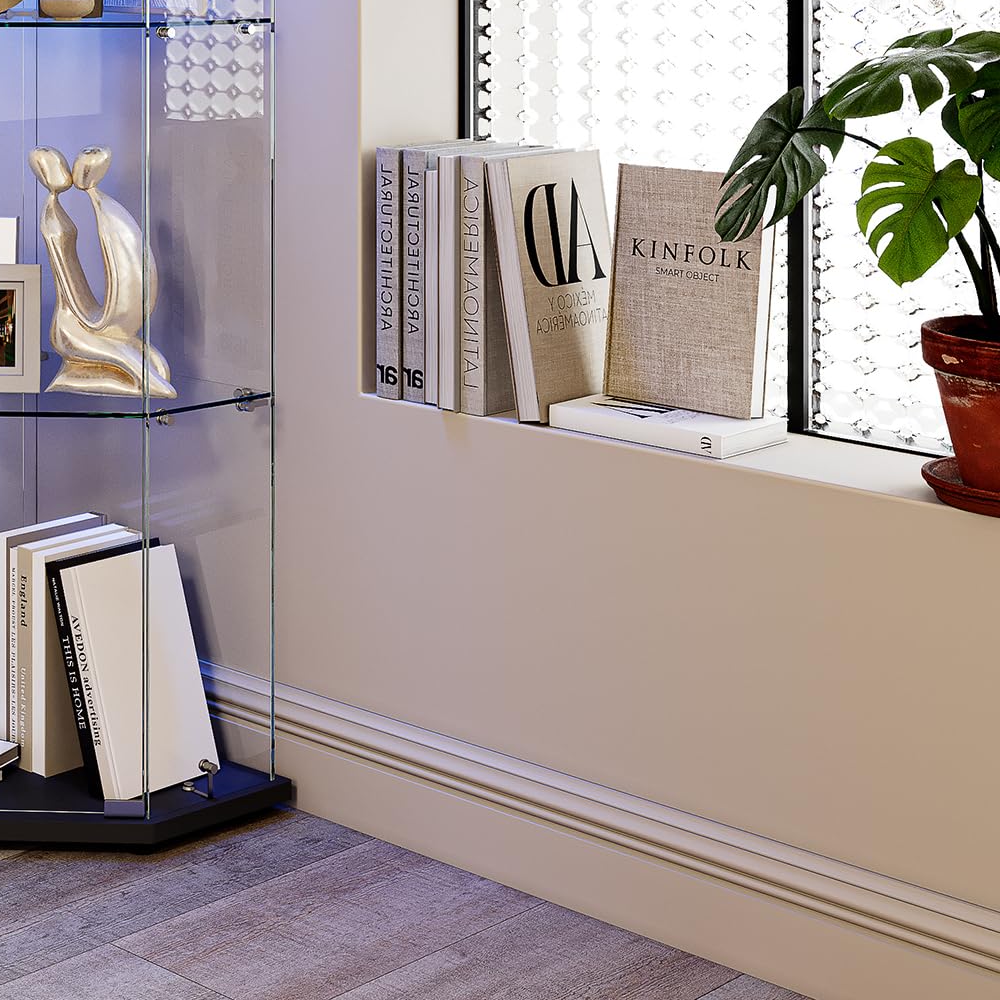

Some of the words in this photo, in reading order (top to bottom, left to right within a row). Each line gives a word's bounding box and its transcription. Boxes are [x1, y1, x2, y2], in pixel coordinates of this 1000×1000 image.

[631, 237, 752, 271] KINFOLK
[655, 266, 684, 278] SMART
[686, 270, 720, 282] OBJECT
[19, 575, 28, 628] England
[62, 635, 74, 668] THIS
[68, 671, 78, 684] IS
[71, 615, 89, 672] AVEDON
[83, 677, 102, 747] advertising
[19, 703, 27, 748] Kingdom
[72, 687, 87, 730] HOME
